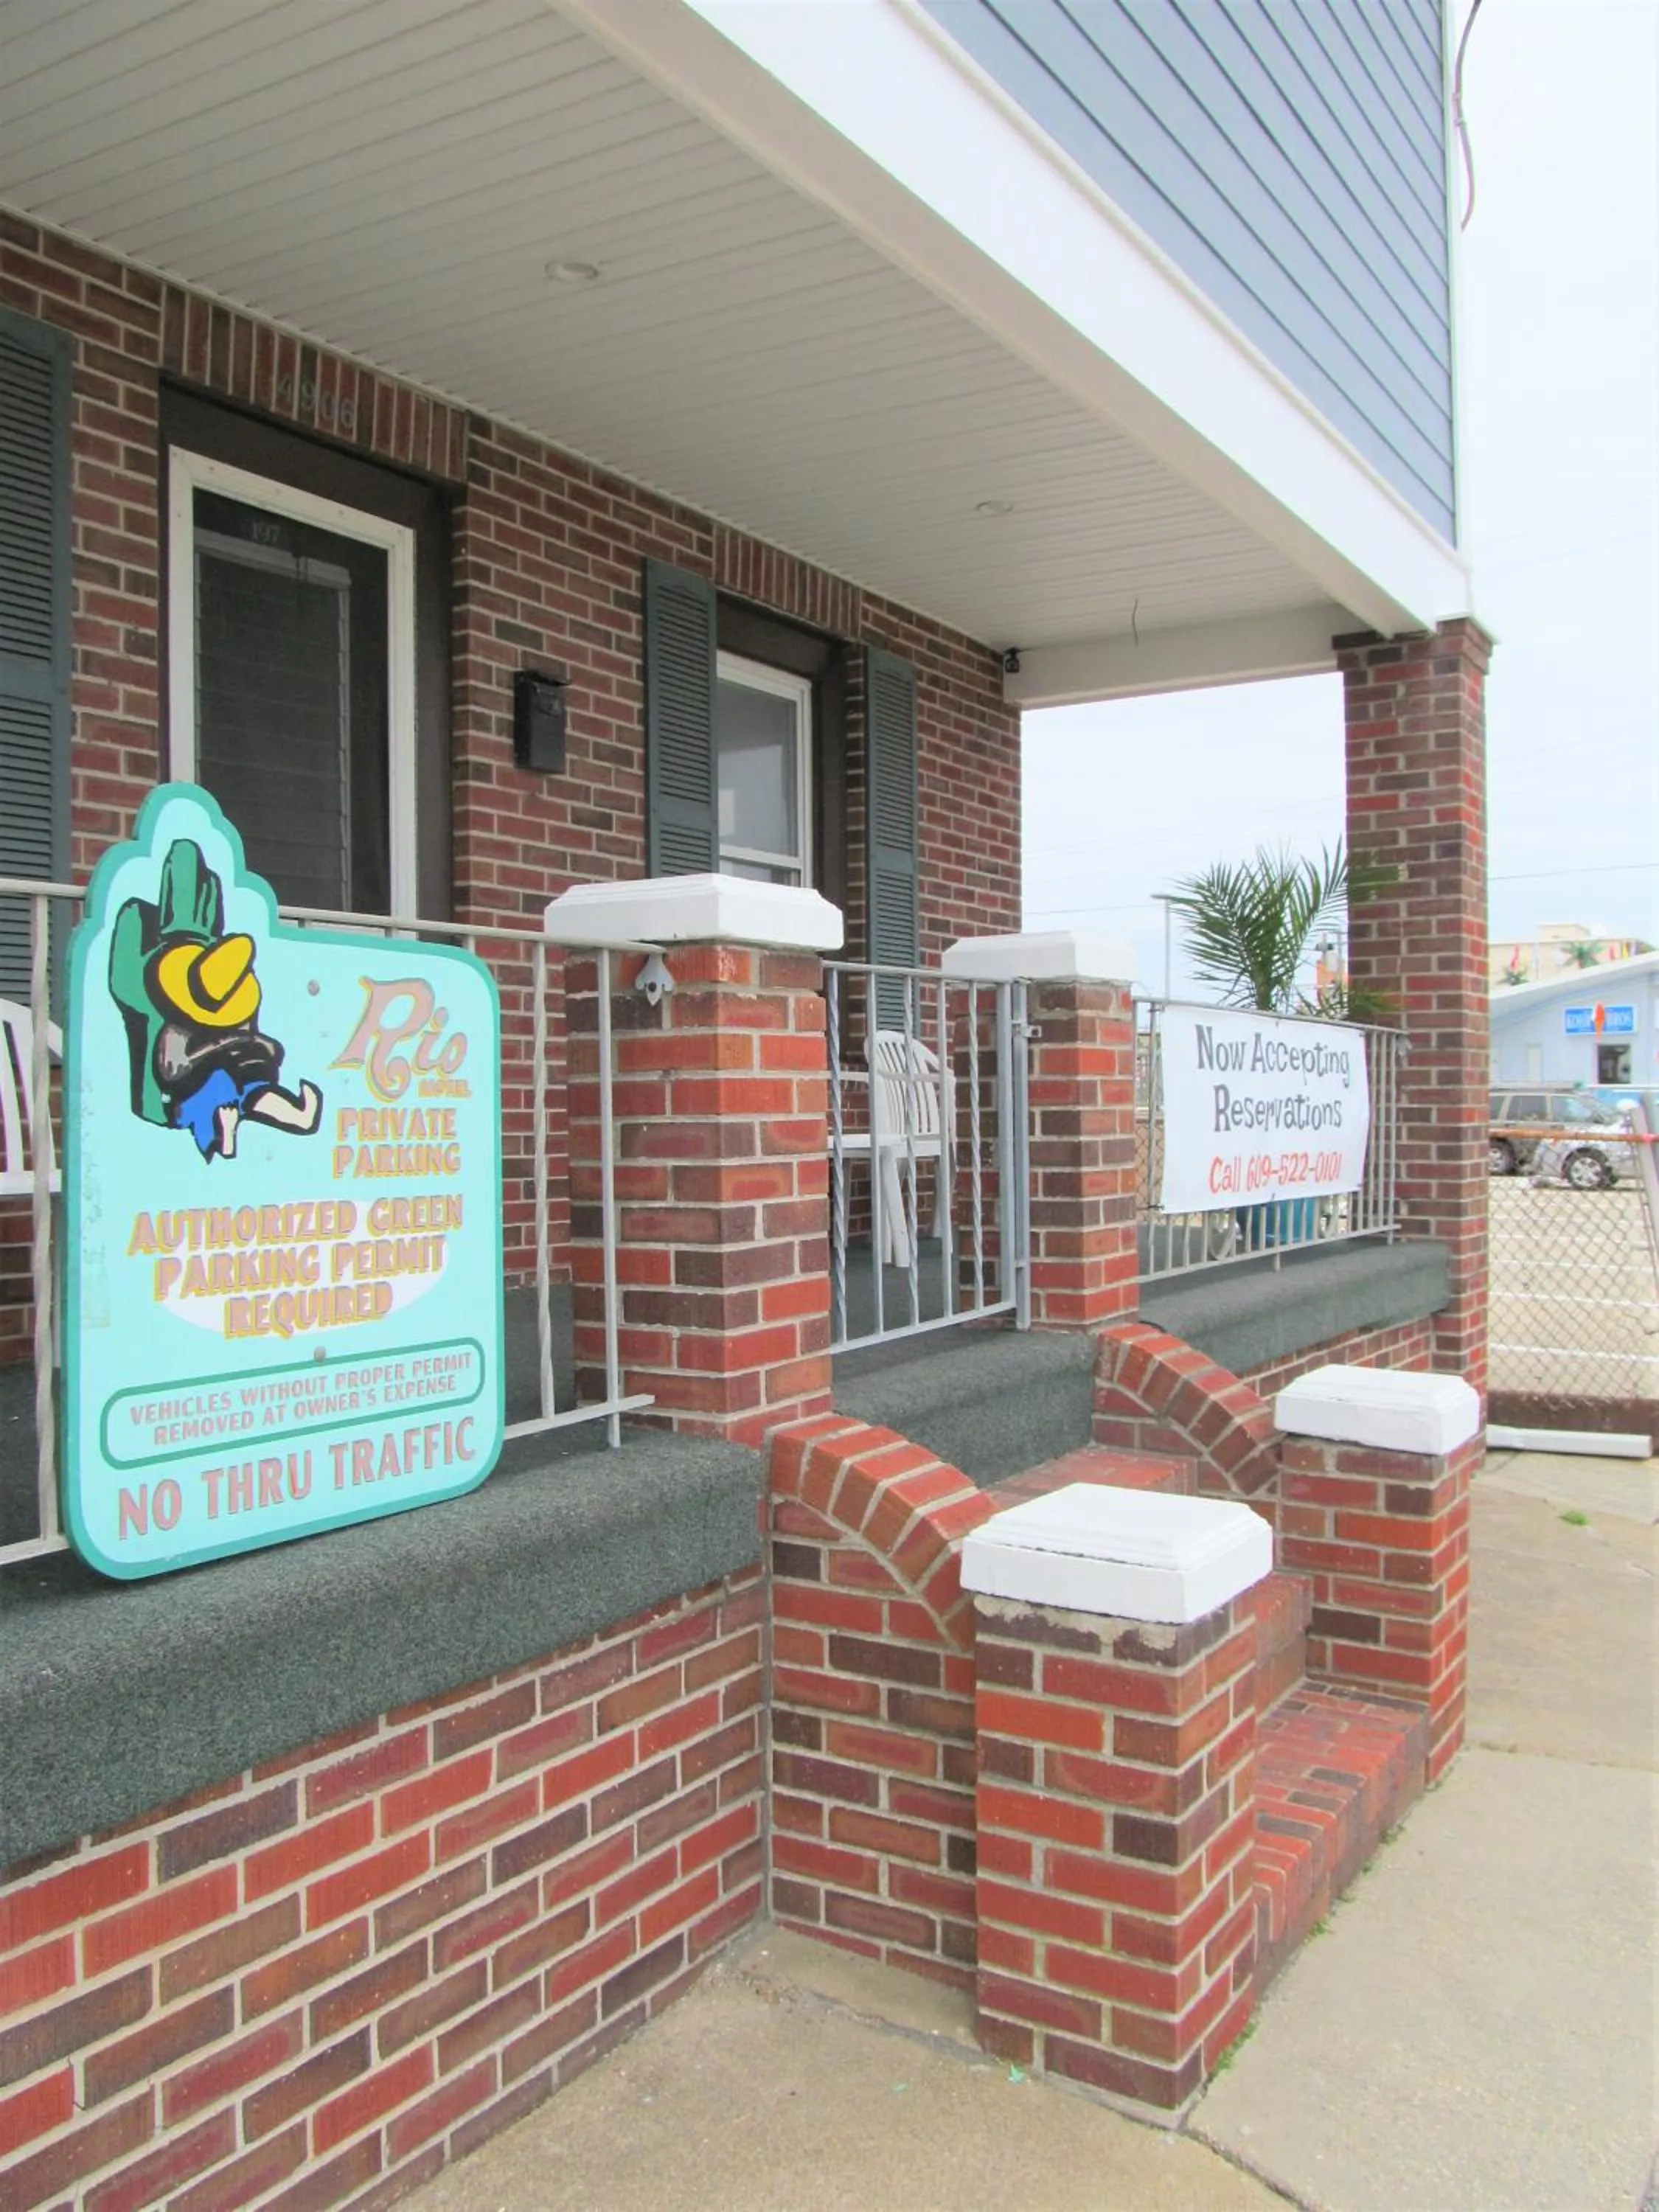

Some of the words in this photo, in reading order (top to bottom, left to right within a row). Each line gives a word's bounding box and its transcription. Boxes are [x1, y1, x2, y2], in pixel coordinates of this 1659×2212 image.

[276, 372, 355, 429] 4906
[327, 975, 468, 1102] Rio
[1194, 1023, 1248, 1071] Now
[1251, 1032, 1349, 1088] Accepting
[335, 1107, 458, 1141] PRIVATE
[1212, 1083, 1343, 1133] Reservations
[332, 1144, 462, 1180] PARKING
[1208, 1155, 1242, 1194] Call
[1246, 1151, 1343, 1192] 609-522-0101
[127, 1200, 358, 1257] AUTHORIZED
[366, 1194, 464, 1234] GREEN
[153, 1244, 320, 1301] PARKING
[330, 1235, 447, 1279] PERMIT
[223, 1281, 394, 1340] REQUIRED
[130, 1392, 232, 1426] VEHICLES
[241, 1376, 327, 1407] WITHOUT
[335, 1363, 406, 1391] PROPER
[412, 1352, 472, 1381] PERMIT
[153, 1411, 255, 1446] REMOVED
[262, 1404, 288, 1426] AT
[294, 1389, 378, 1419] OWNER'S
[384, 1374, 457, 1403] EXPENSE
[118, 1478, 183, 1540] NO
[201, 1450, 313, 1520] THRU
[329, 1416, 476, 1490] TRAFFIC
